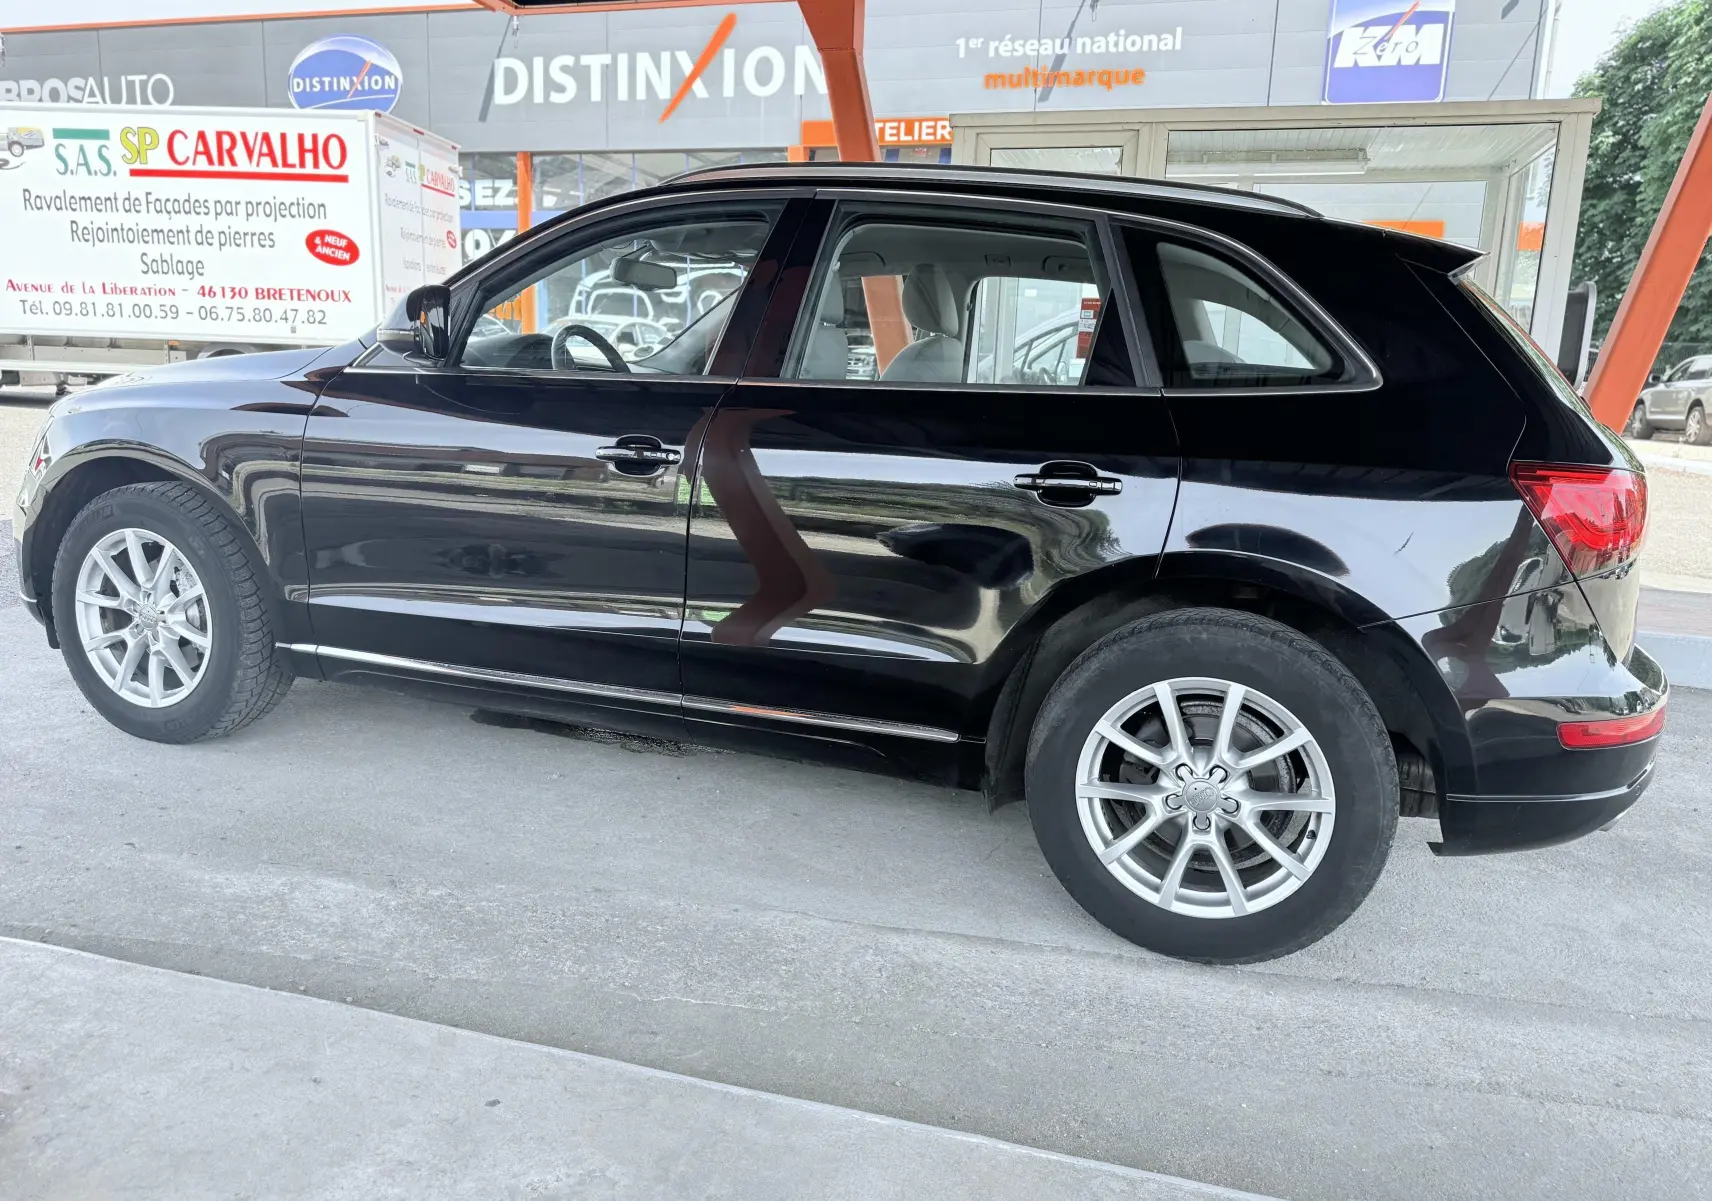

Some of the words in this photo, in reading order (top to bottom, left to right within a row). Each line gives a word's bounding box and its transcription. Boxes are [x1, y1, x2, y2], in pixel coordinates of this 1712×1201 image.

[988, 34, 1069, 58] réseau
[1076, 27, 1183, 54] national
[492, 12, 827, 124] DISTINXION
[984, 65, 1146, 92] multimarque
[875, 121, 952, 141] TELIER
[55, 143, 117, 177] S.A.S.
[119, 127, 160, 164] SP
[167, 129, 347, 170] CARVALHO
[23, 188, 118, 213] Ravalement
[122, 191, 141, 213] de
[146, 192, 211, 219] Façades
[214, 199, 241, 221] par
[245, 196, 327, 222] projection
[70, 220, 191, 247] Rejointoiement
[195, 224, 214, 246] de
[218, 226, 275, 251] pierres
[324, 234, 348, 247] NEUF
[141, 252, 205, 279] Sablage
[315, 244, 351, 261] ANCIEN
[197, 285, 248, 299] 46130
[255, 287, 352, 302] BRETENOUX
[19, 299, 49, 315] Tél.
[53, 300, 179, 320] 09.81.81.00.59
[198, 305, 327, 325] 06.75.80.47.82
